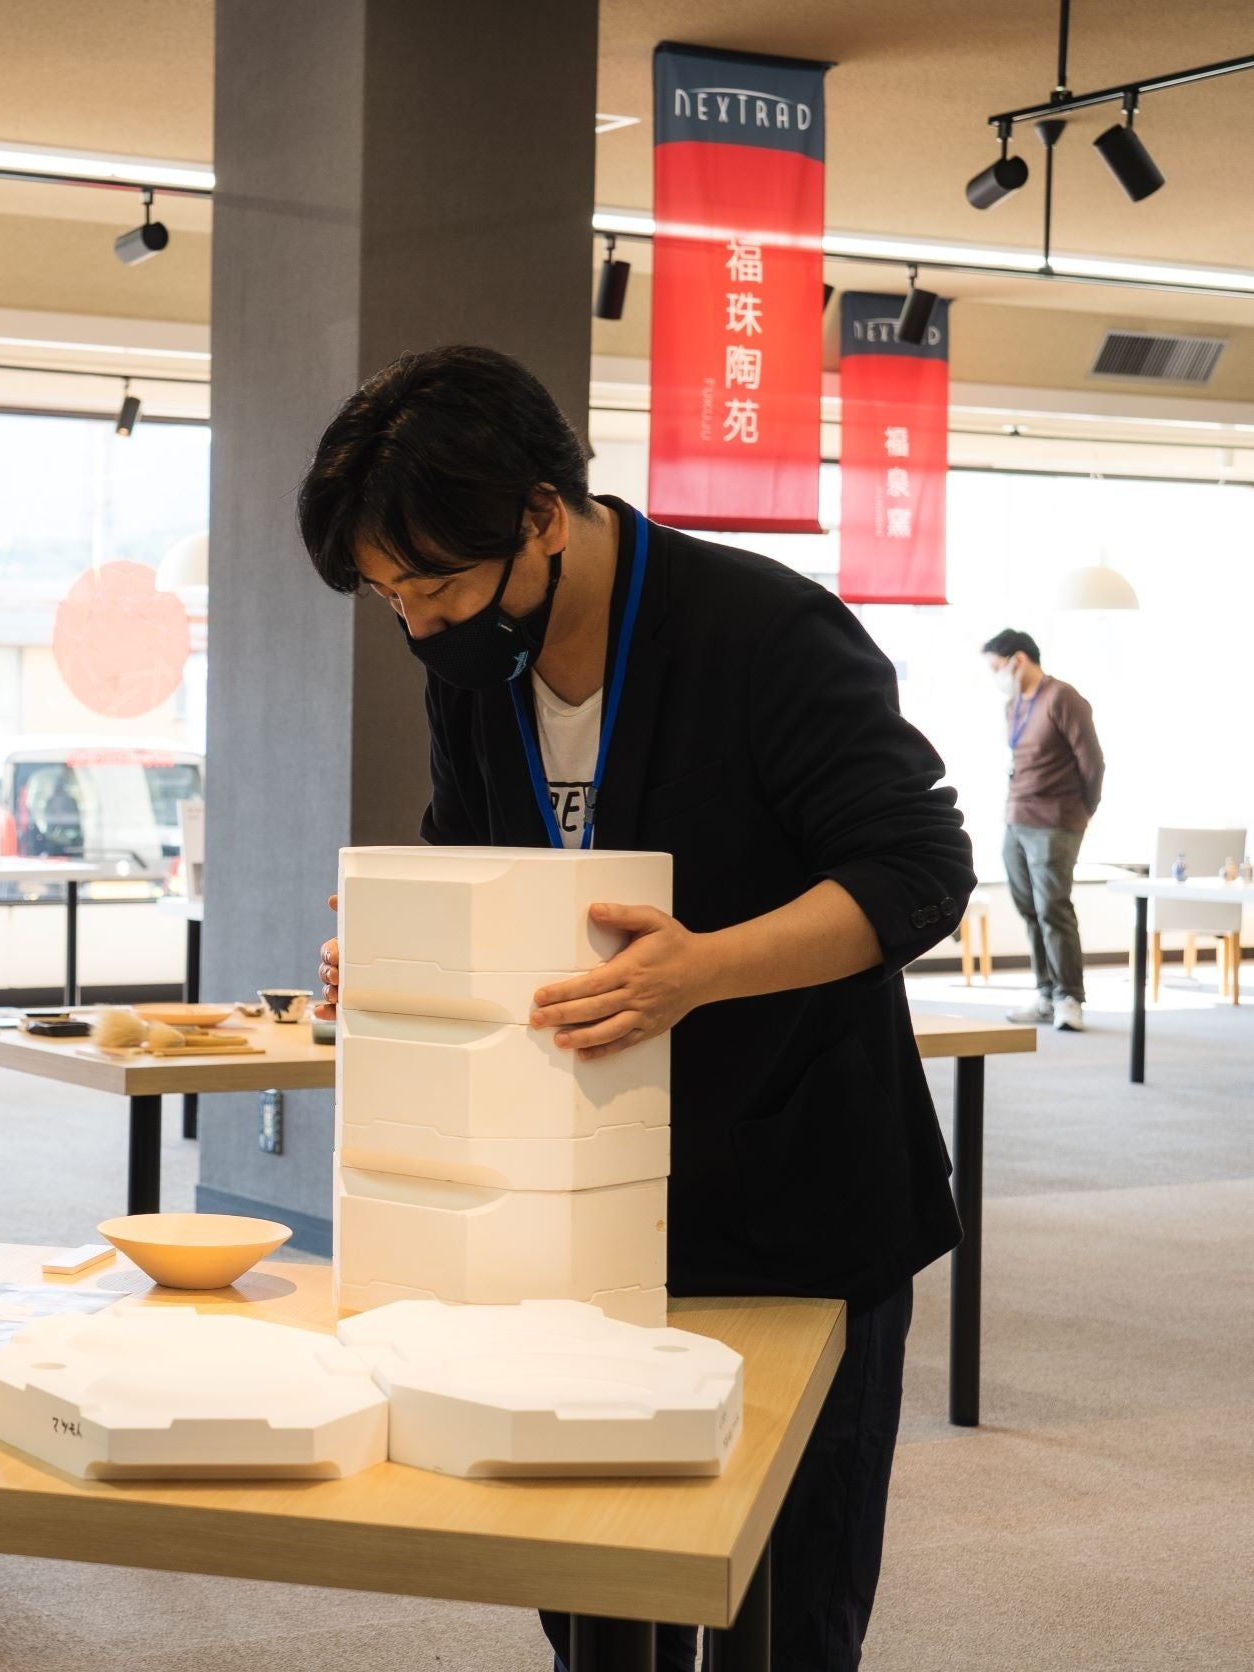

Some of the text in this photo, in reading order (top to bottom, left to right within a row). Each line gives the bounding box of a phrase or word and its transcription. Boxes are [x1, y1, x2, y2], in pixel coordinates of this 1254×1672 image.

[723, 237, 763, 444] 福珠陶苑
[853, 318, 941, 346] NEXTD
